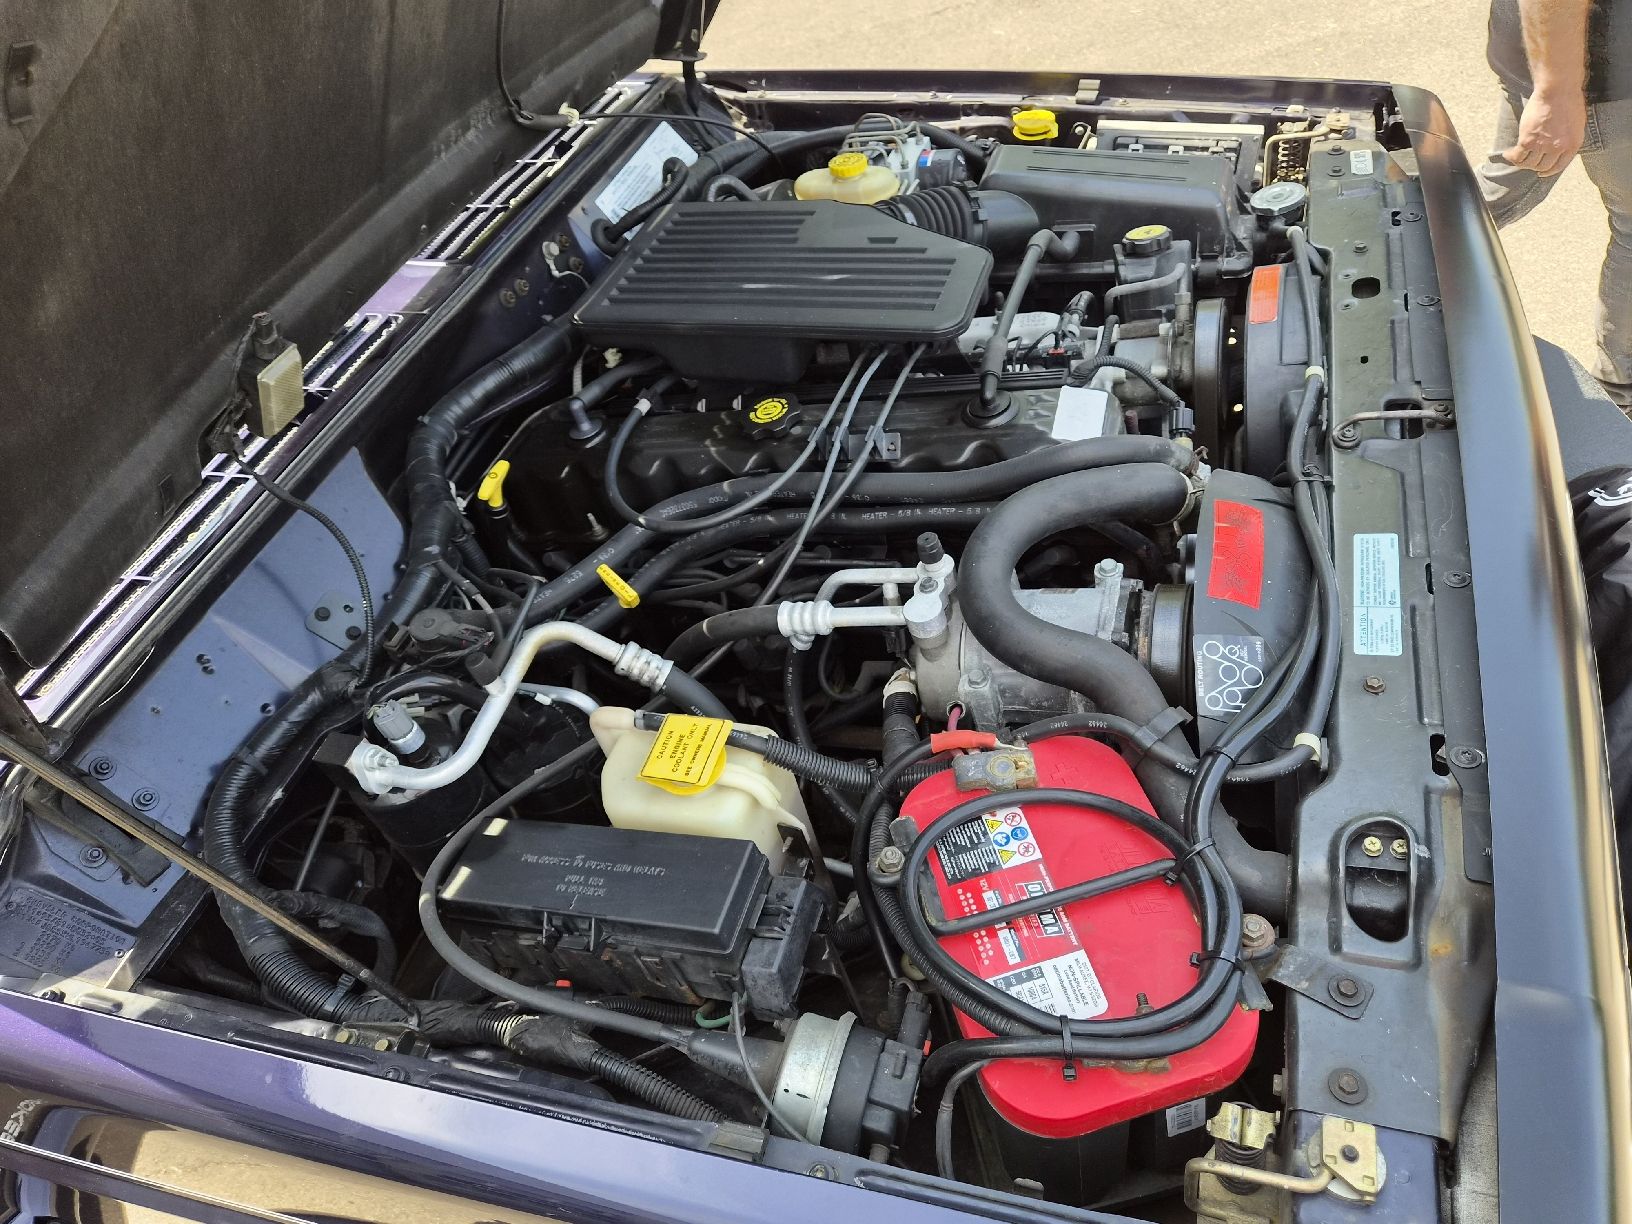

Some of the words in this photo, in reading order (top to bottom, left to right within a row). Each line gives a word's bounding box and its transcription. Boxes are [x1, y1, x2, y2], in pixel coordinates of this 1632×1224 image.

[786, 512, 808, 520] HEATE
[862, 511, 888, 520] HEATER
[1196, 651, 1205, 681] ROUTING
[656, 730, 675, 760] CAUTION
[669, 733, 686, 759] ENGINE
[671, 741, 690, 773] COOLANT
[686, 722, 700, 741] ONLY
[684, 764, 693, 777] SEE
[979, 879, 990, 893] 12V
